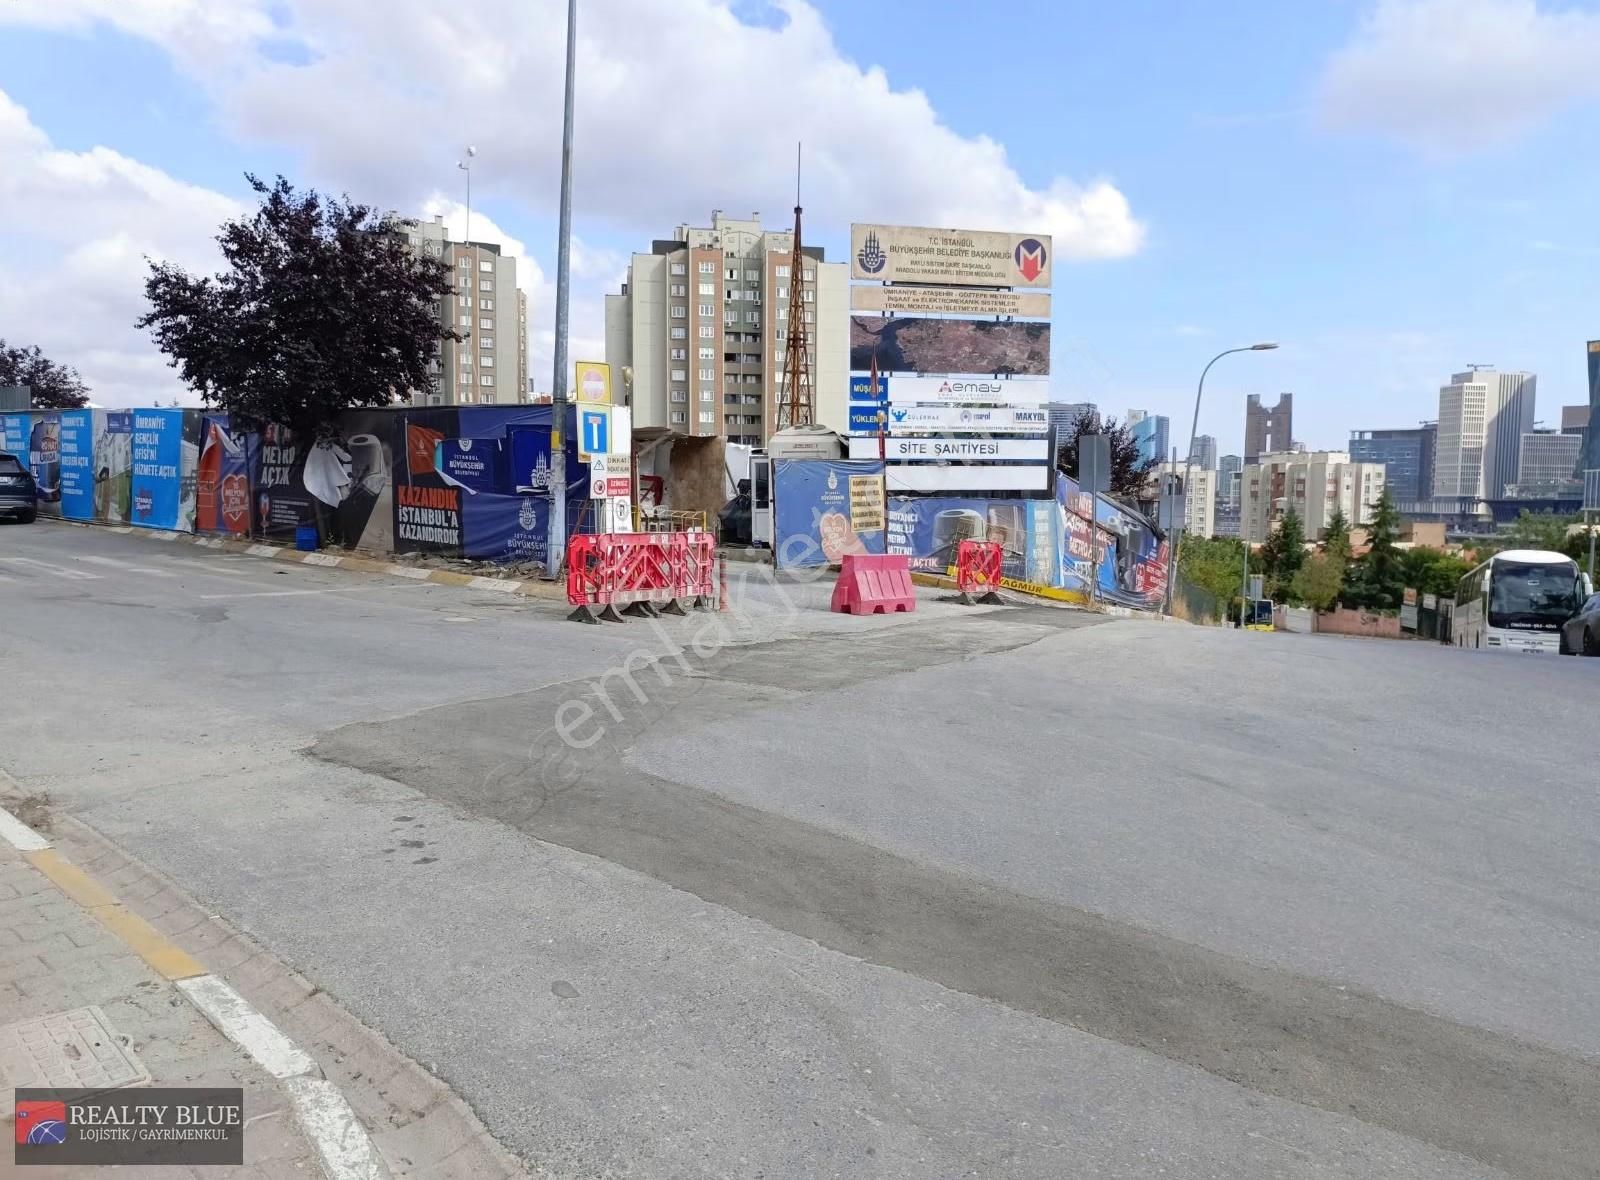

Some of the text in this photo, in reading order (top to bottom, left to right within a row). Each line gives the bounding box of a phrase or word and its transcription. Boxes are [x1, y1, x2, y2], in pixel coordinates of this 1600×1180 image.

[941, 236, 975, 248] İSTANBUL
[889, 245, 1012, 260] BÜYÜKŞEHİR BELEDİYE BAŞKANLIĞI
[136, 414, 166, 430] ÜMRANİYE
[135, 432, 159, 446] GENÇLİK
[262, 446, 296, 464] METRO
[899, 442, 999, 456] SİTE ŞANTİYESİ
[134, 463, 177, 480] HİZMETE AÇTIK
[398, 485, 458, 510] KAZANDIK
[398, 504, 459, 528] İSTANBUL'A
[399, 524, 460, 545] KAZANDIRDIK
[508, 540, 548, 550] BÜYÜKŞEHİ
[912, 558, 938, 568] AÇTIK
